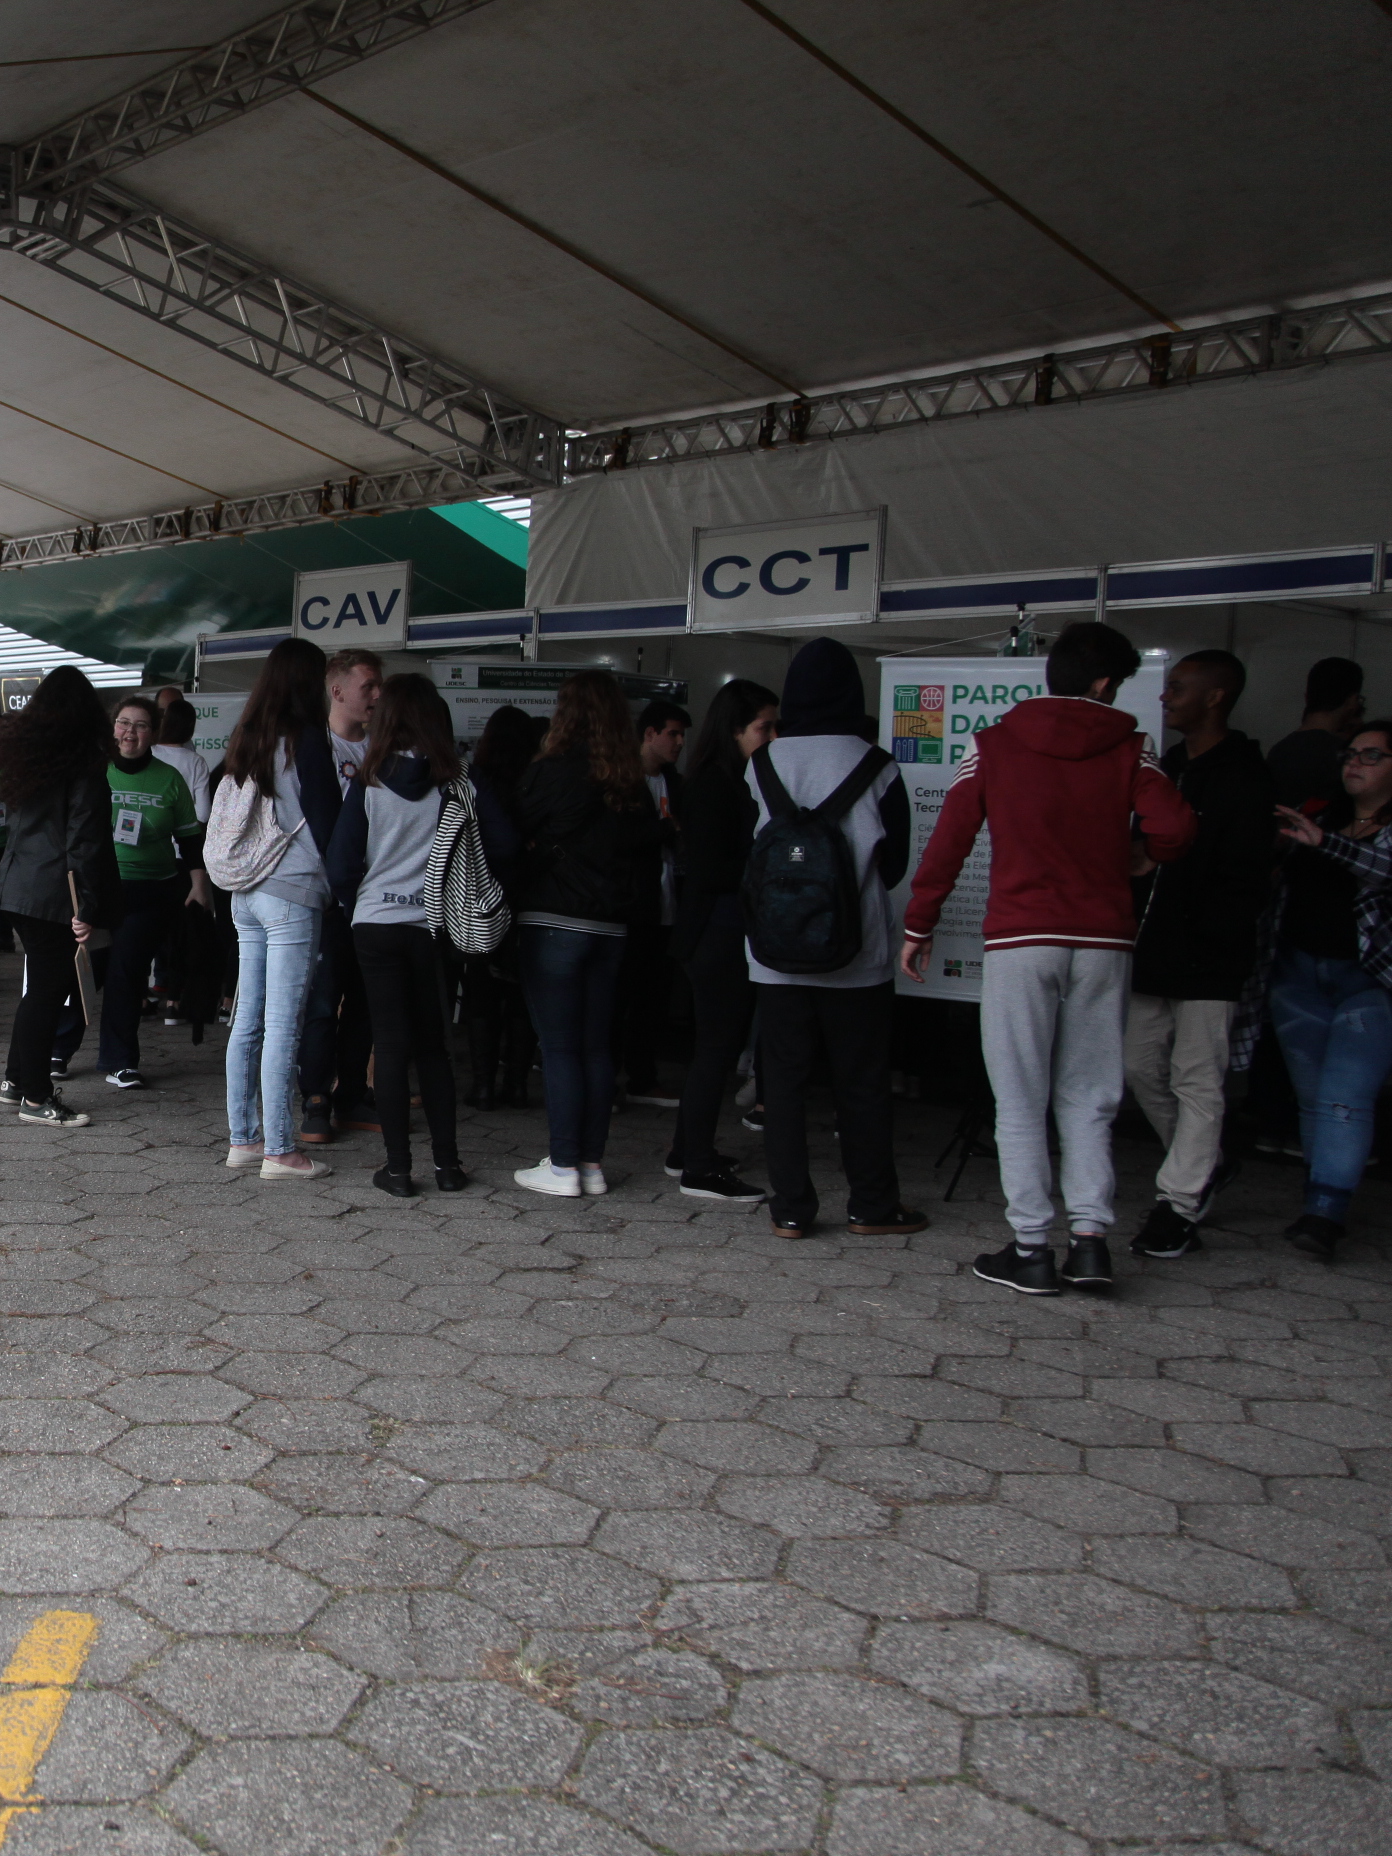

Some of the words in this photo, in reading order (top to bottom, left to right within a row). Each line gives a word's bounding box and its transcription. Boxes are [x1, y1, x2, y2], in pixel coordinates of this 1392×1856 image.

[702, 543, 869, 600] CCT
[300, 588, 402, 630] CAV
[455, 697, 481, 705] ENSINO,
[481, 697, 512, 705] PESQUISA
[519, 697, 552, 705] EXTENSÃO
[382, 892, 425, 907] Helo
